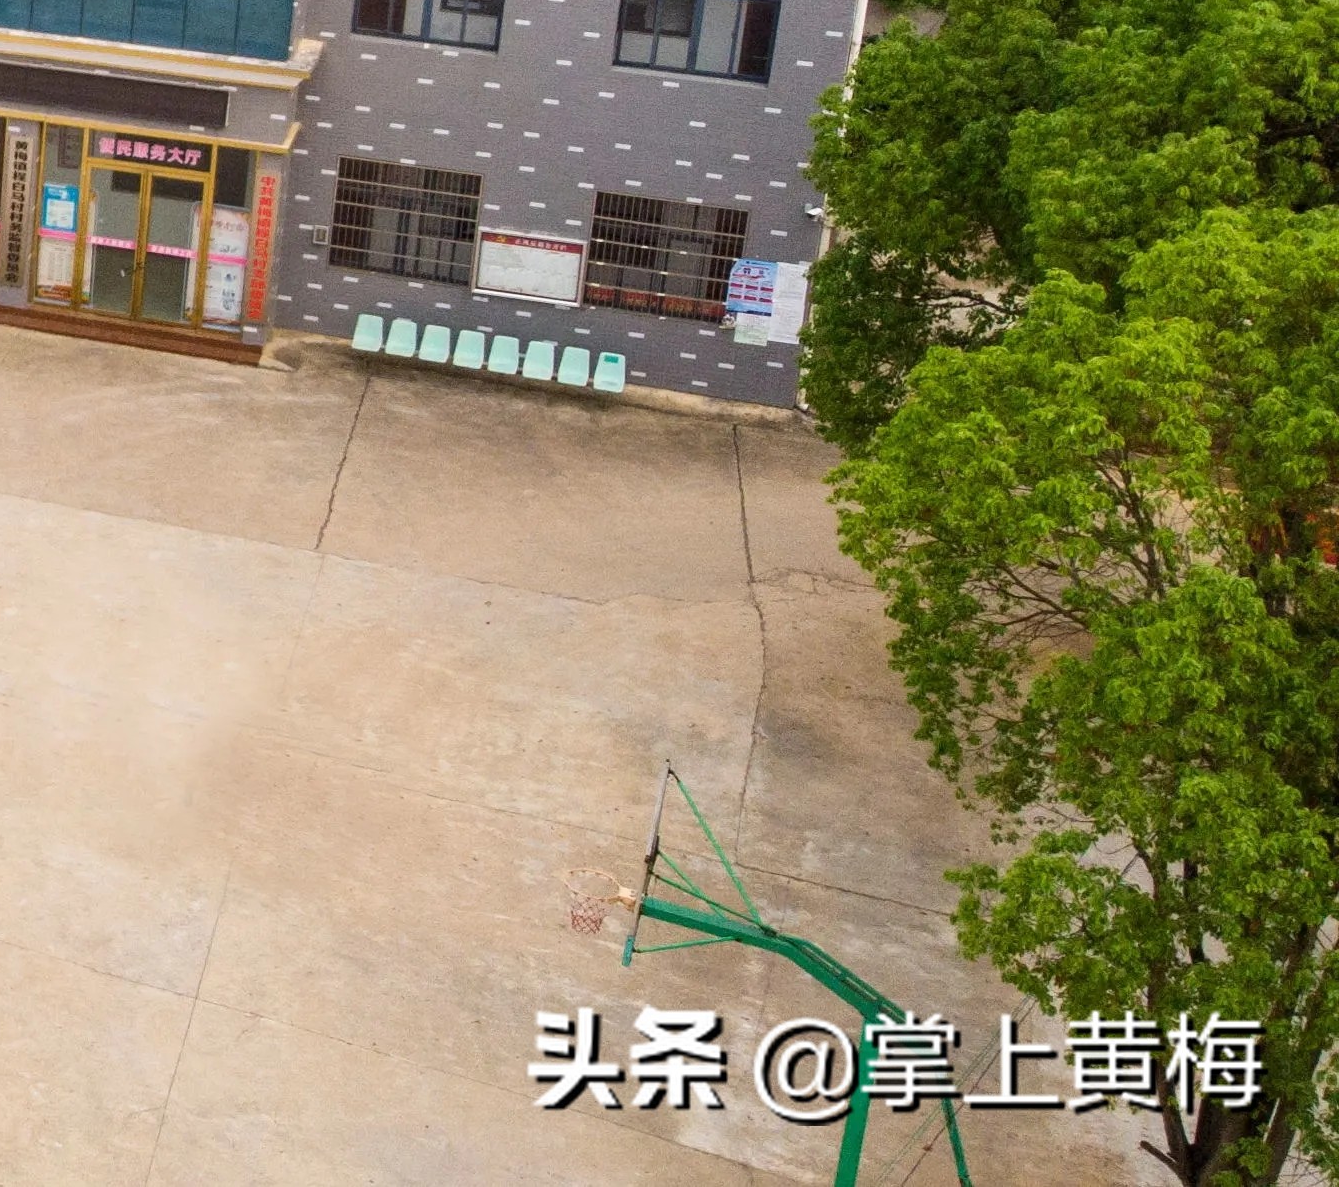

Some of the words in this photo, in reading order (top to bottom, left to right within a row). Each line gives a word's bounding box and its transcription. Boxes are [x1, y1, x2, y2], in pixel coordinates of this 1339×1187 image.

[98, 137, 202, 166] 便民服务大厅
